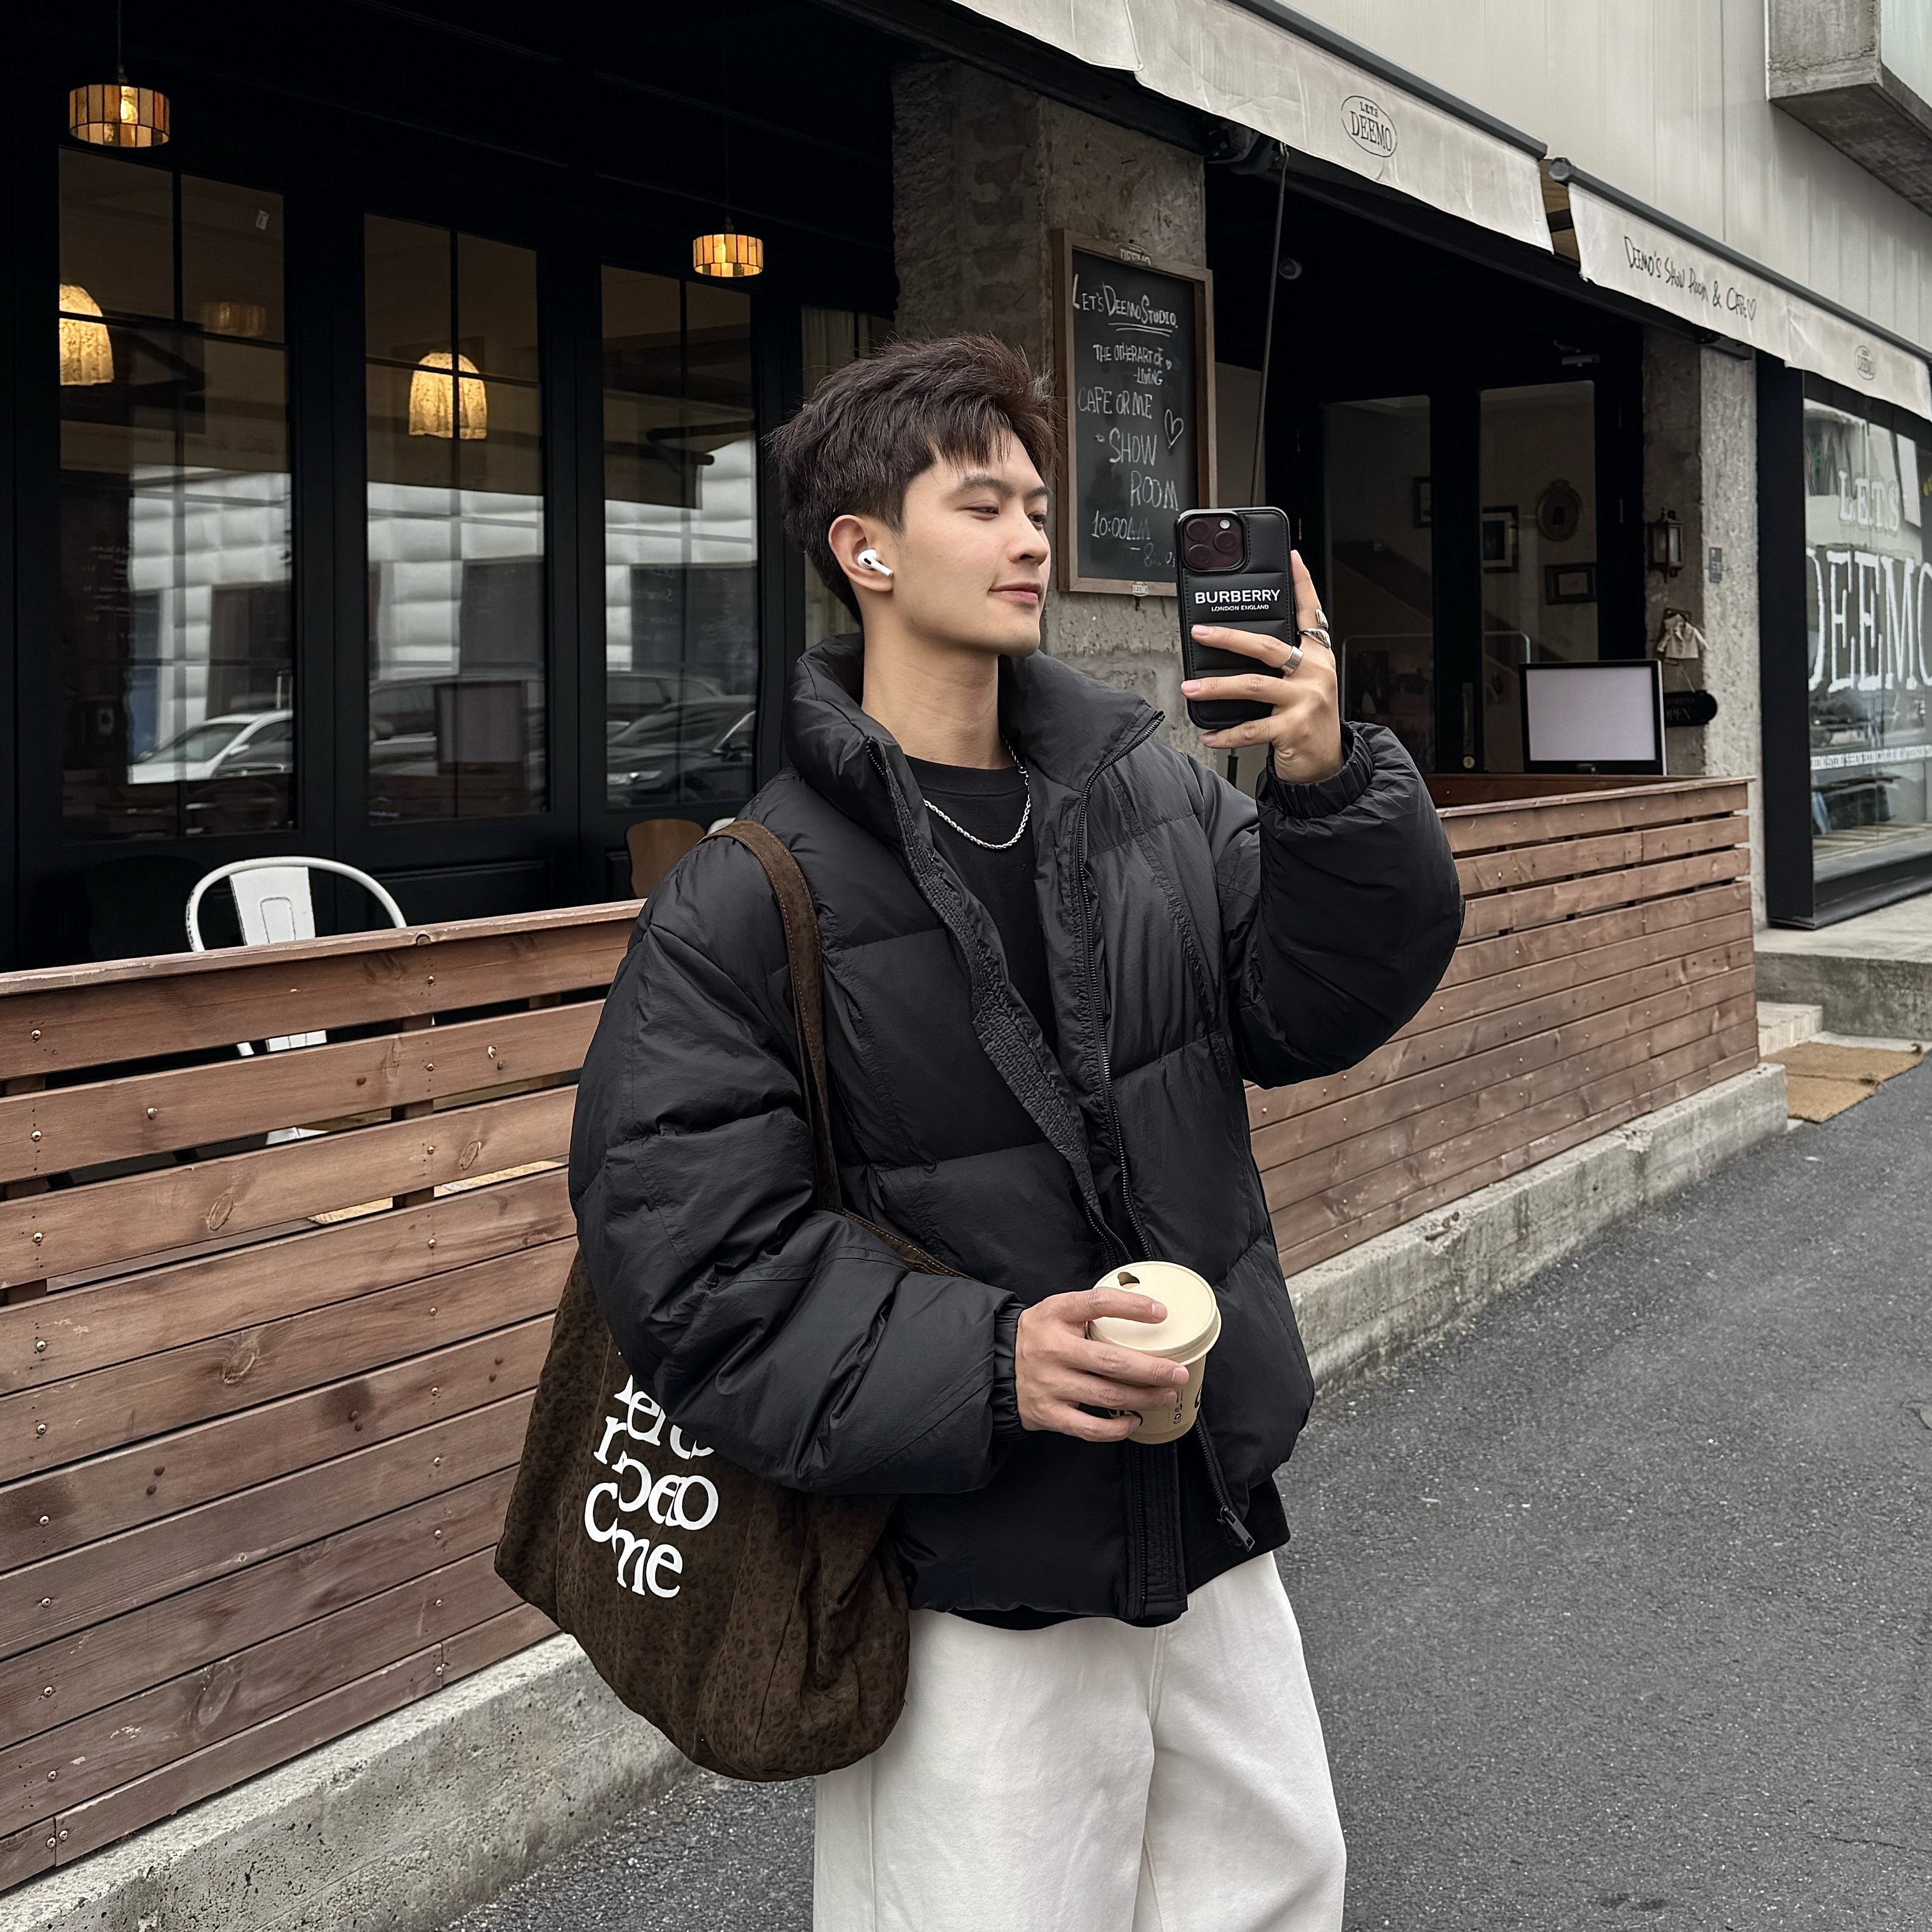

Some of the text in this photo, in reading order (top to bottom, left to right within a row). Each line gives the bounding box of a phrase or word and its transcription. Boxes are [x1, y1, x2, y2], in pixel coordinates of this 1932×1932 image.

[1350, 111, 1392, 151] DEEMO
[1712, 280, 1722, 309] &
[1093, 344, 1112, 363] THE
[1078, 386, 1112, 414] CAFE
[1132, 392, 1153, 420] ME
[1109, 427, 1157, 467] SHOW
[1131, 470, 1179, 511] ROOM
[1195, 589, 1280, 604] BURBERRY
